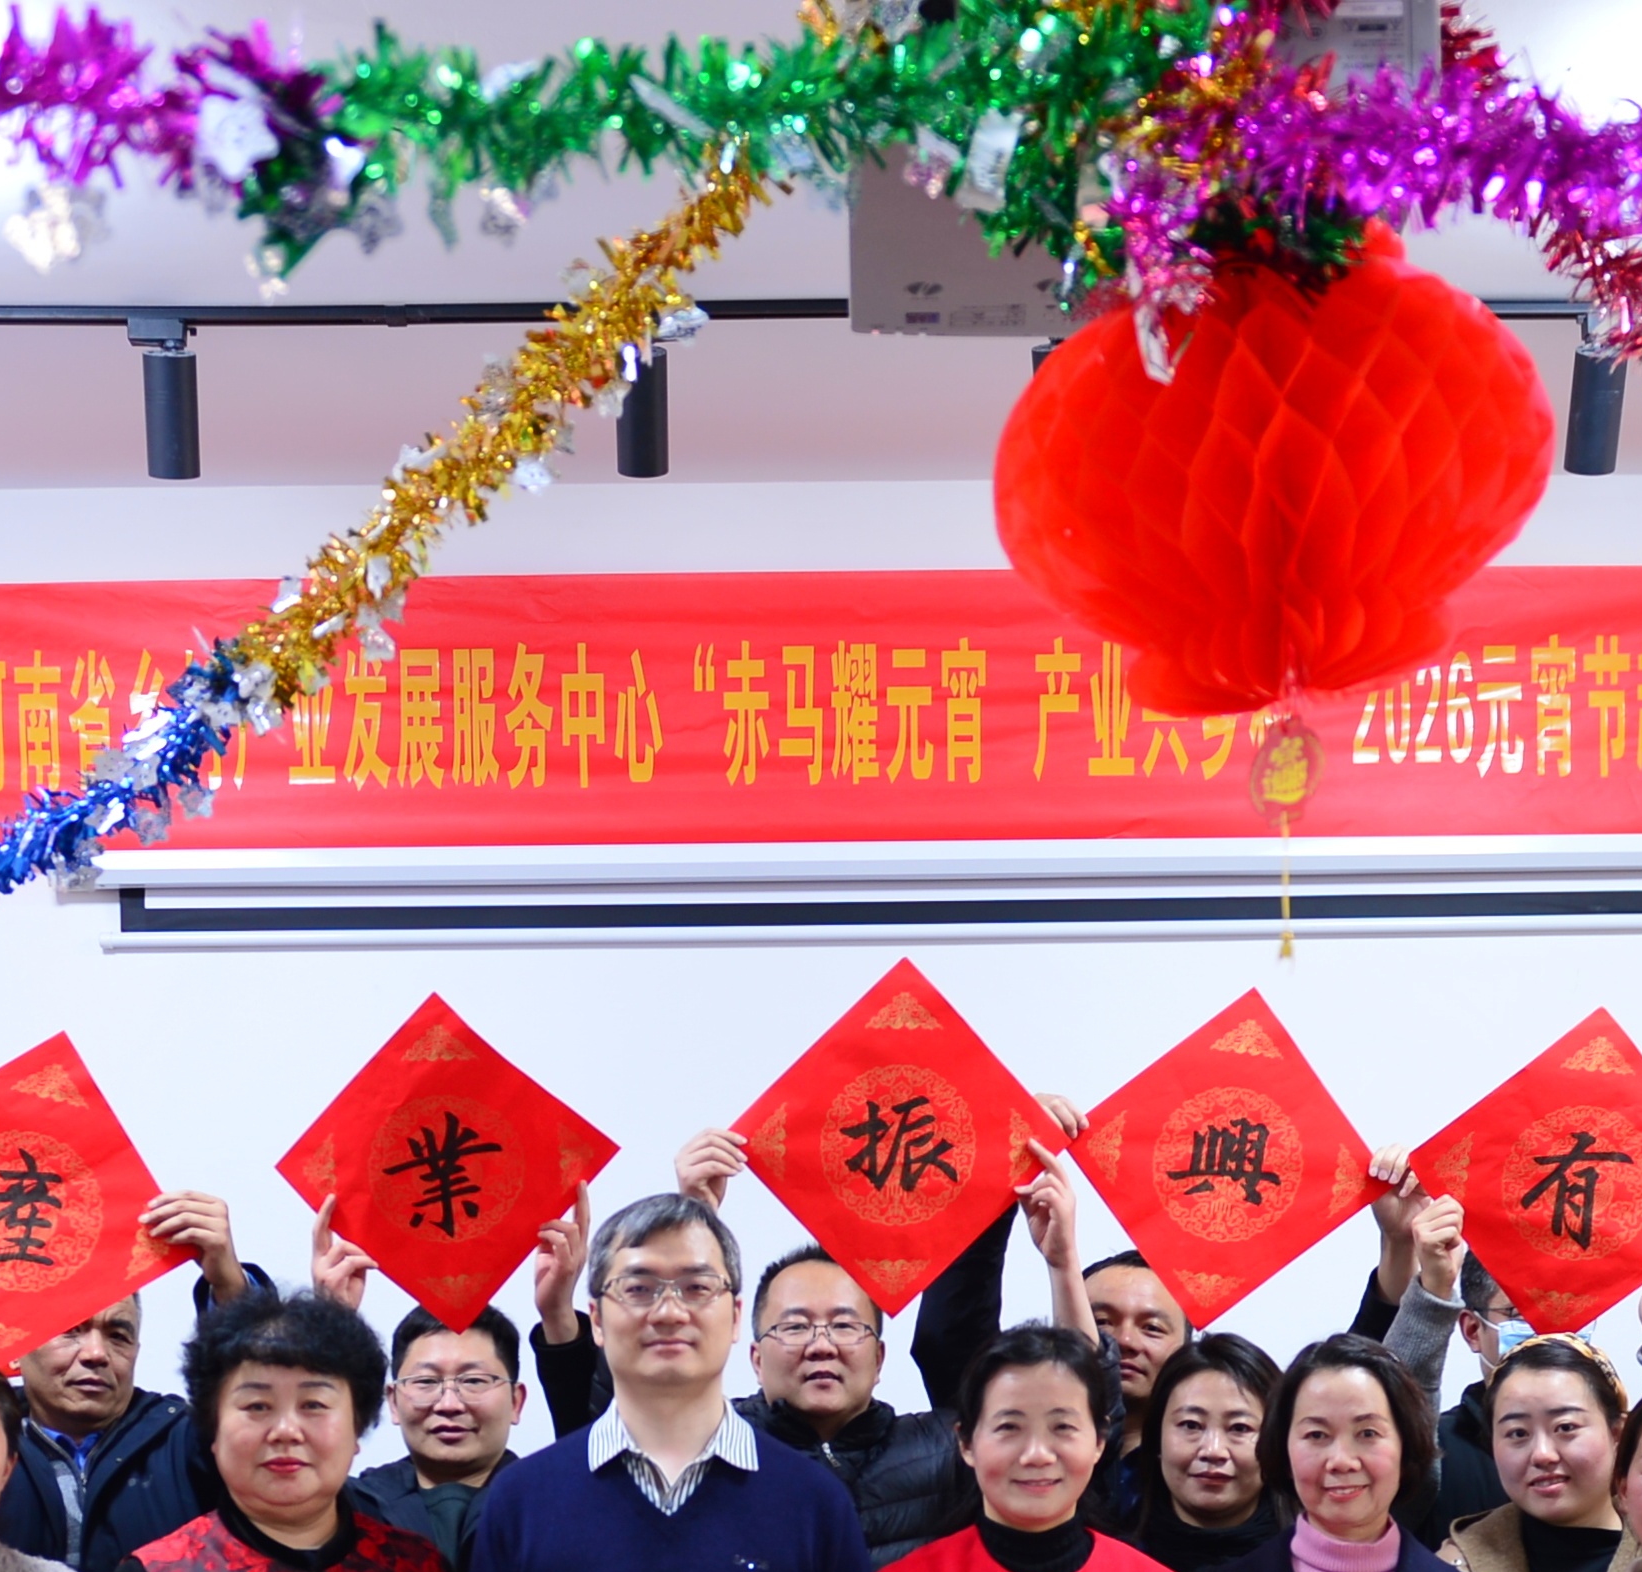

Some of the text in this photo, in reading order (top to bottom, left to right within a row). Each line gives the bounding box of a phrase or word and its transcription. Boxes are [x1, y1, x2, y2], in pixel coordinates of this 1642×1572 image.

[382, 1110, 504, 1238] 業
[839, 1095, 959, 1193] 振
[1167, 1117, 1282, 1206] 興
[1520, 1131, 1633, 1251] 有
